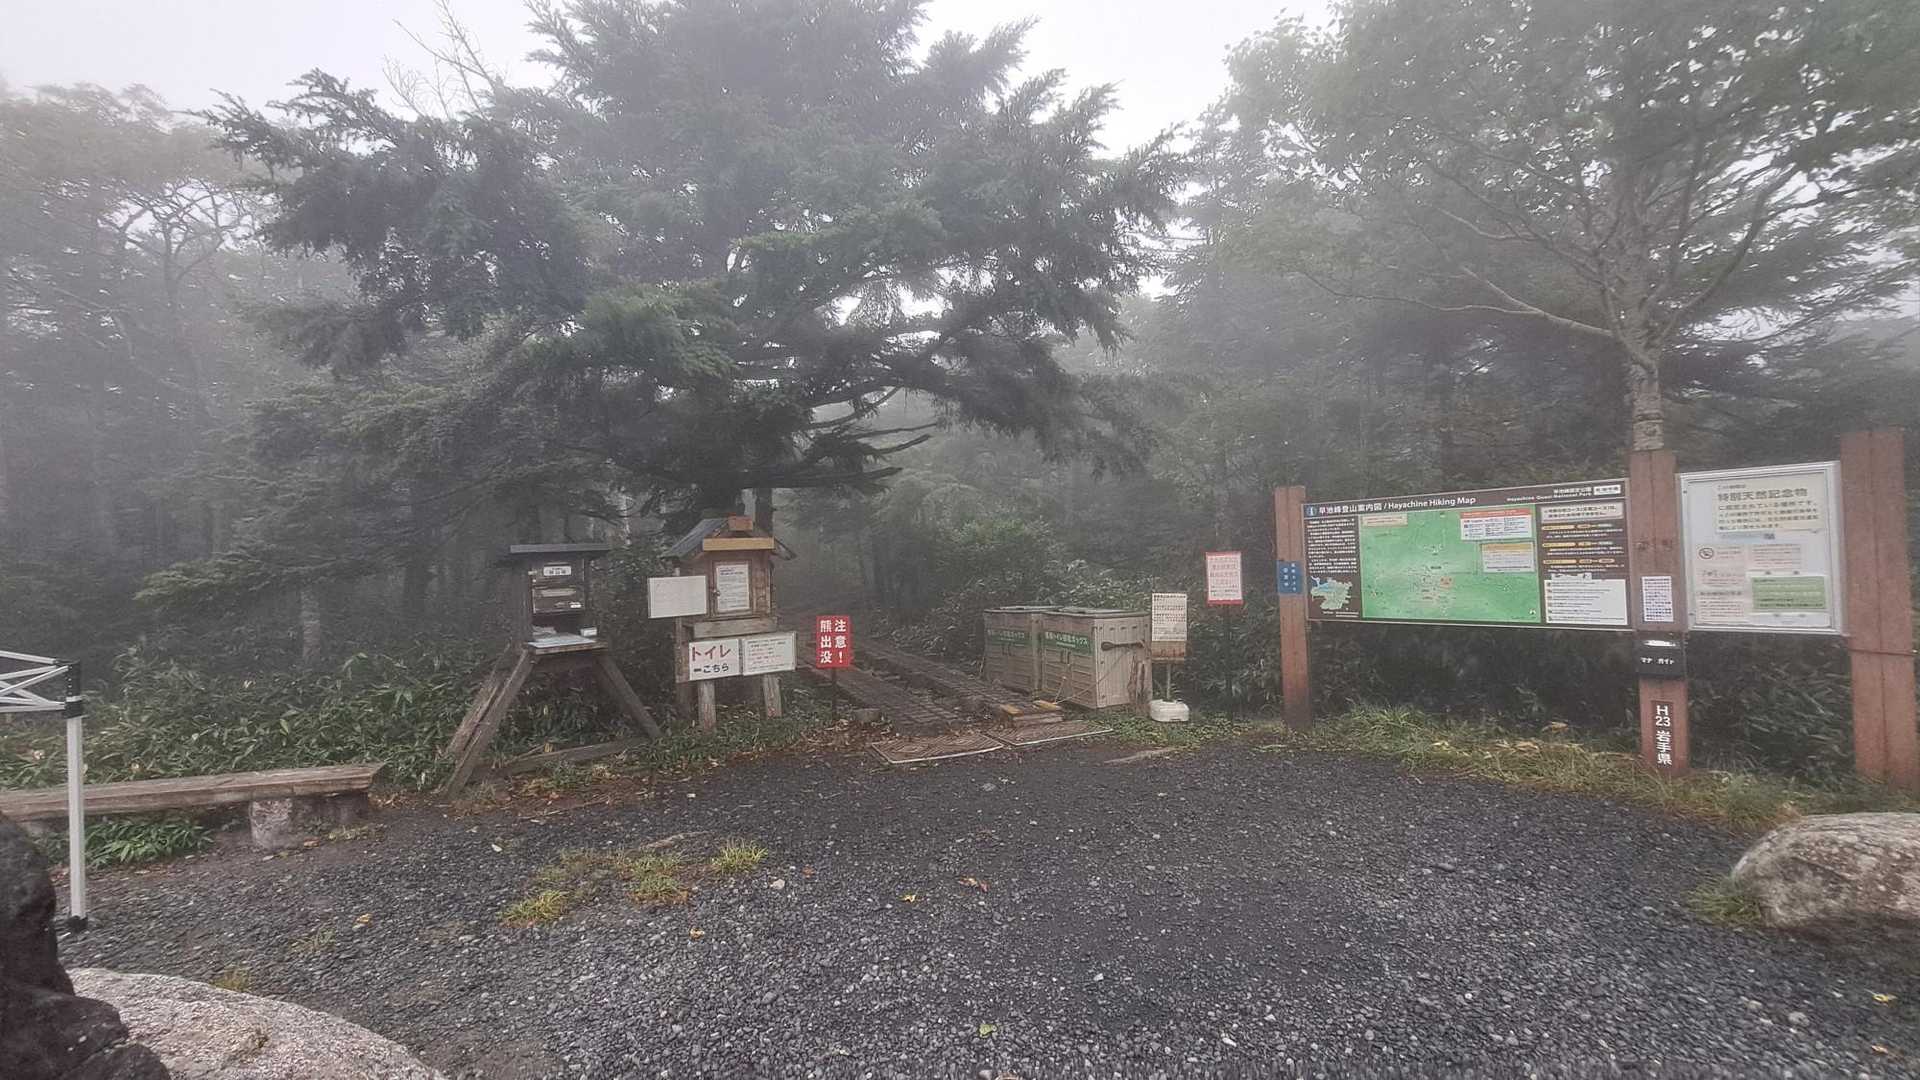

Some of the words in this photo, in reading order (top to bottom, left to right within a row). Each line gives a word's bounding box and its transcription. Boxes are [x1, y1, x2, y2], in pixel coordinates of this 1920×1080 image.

[1388, 500, 1429, 511] Hayachine
[1429, 497, 1456, 507] Hiking
[1457, 496, 1477, 505] Map
[820, 619, 832, 664] 熊出没
[691, 644, 732, 661] トイレ
[703, 663, 729, 674] こちら
[1656, 704, 1669, 716] H
[1655, 715, 1671, 727] 23
[1656, 730, 1673, 765] 岩手県
